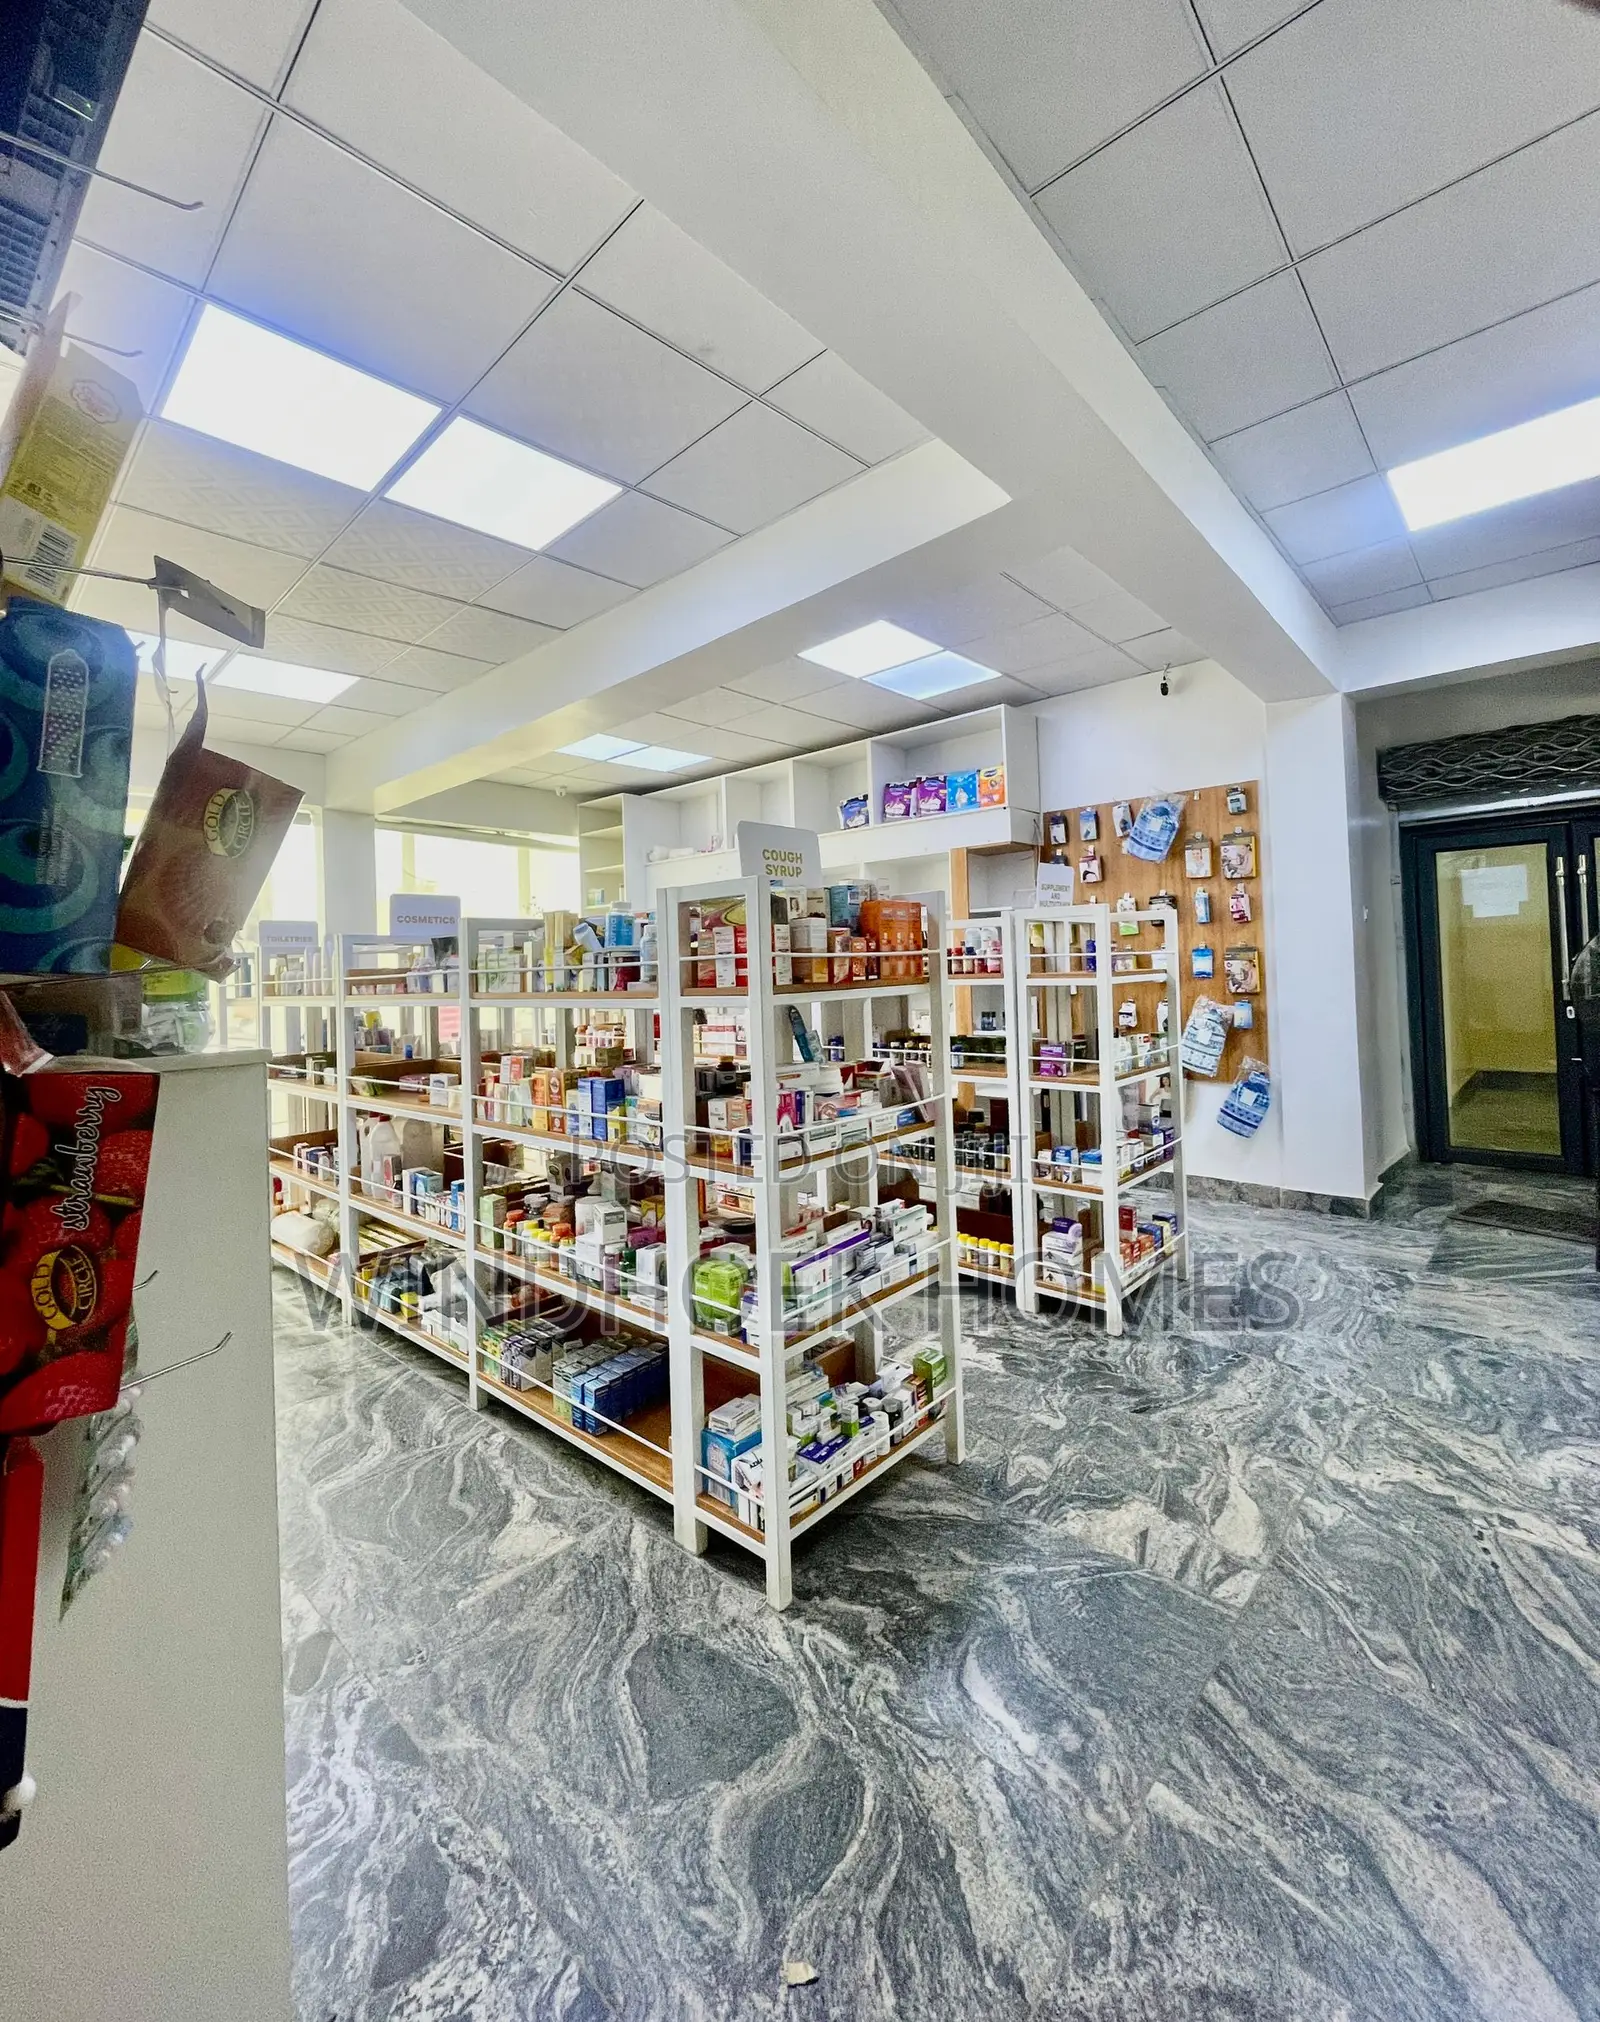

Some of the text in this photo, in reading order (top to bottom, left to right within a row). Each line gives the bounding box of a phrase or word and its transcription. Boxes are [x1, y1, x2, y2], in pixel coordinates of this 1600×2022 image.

[205, 793, 251, 848] GOLD CIRCLE
[762, 848, 803, 864] COUGH
[765, 863, 802, 878] SYRUP
[396, 915, 456, 924] COSMETICS
[266, 935, 313, 943] TOILETRIES
[51, 1086, 122, 1231] strawberry
[34, 1256, 94, 1321] GOLD CIRCLE
